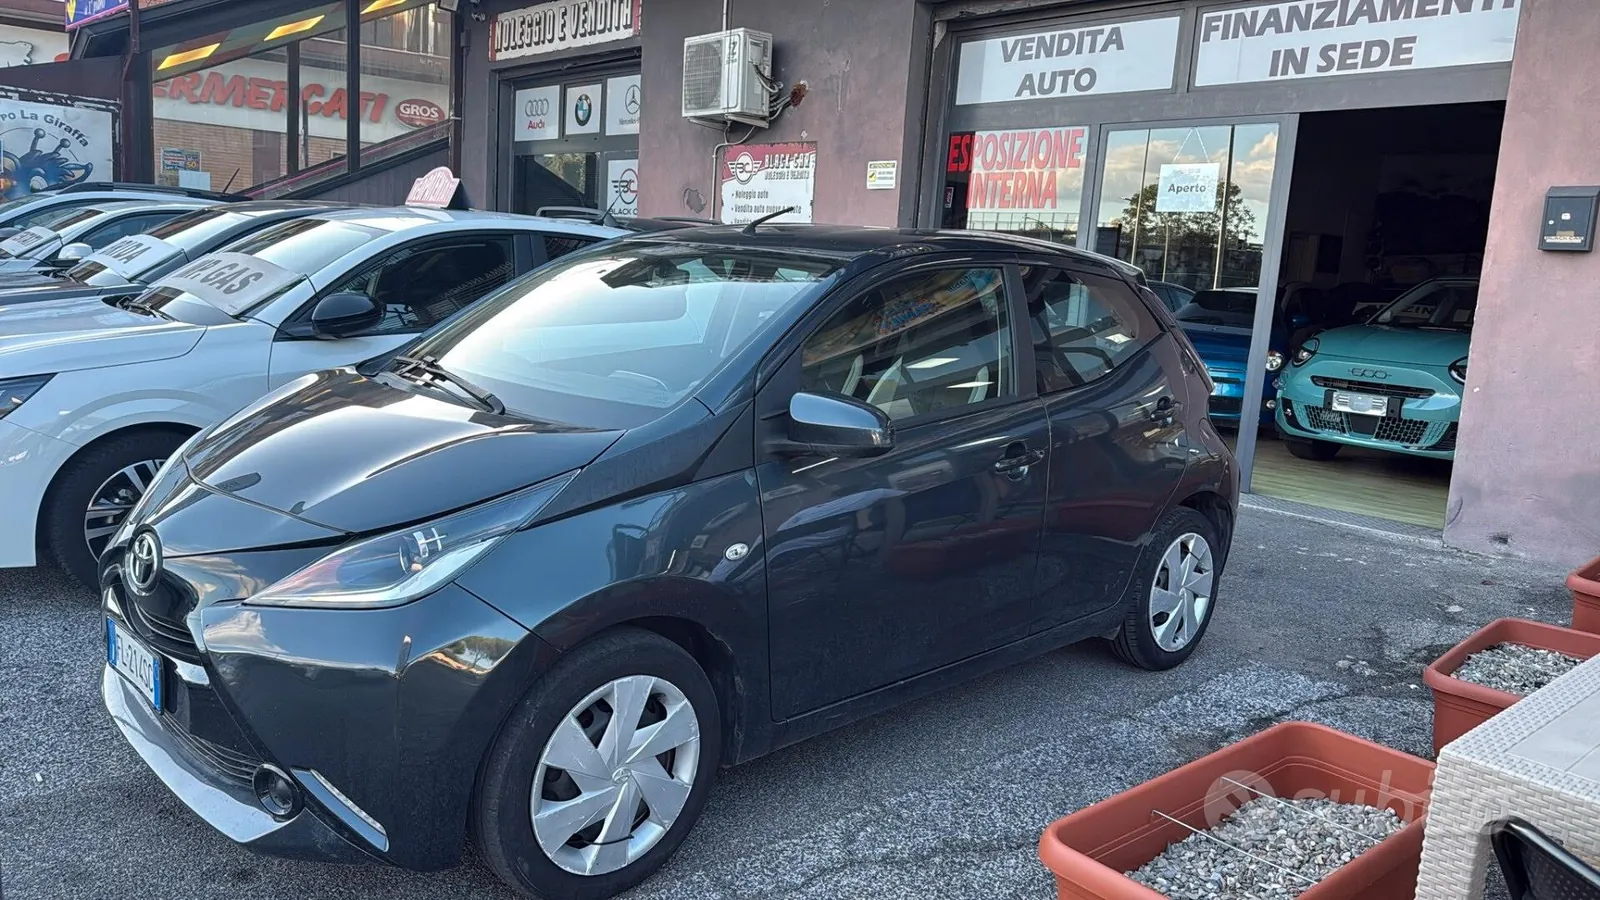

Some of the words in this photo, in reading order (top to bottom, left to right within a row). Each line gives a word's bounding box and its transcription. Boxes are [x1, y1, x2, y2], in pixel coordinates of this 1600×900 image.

[495, 9, 555, 52] NOLEGGIO
[558, 5, 567, 41] E
[1001, 26, 1125, 63] VENDITA
[1268, 46, 1309, 77] IN
[1316, 35, 1418, 73] SEDE
[1014, 67, 1098, 98] AUTO
[20, 109, 38, 120] La
[43, 114, 89, 147] Giraffa
[399, 103, 440, 119] GROS
[527, 120, 545, 130] Audi
[948, 128, 1085, 173] ESPOSIZIONE
[965, 171, 1058, 210] INTERNA
[1167, 183, 1207, 195] Aperto
[199, 262, 264, 295] GAS
